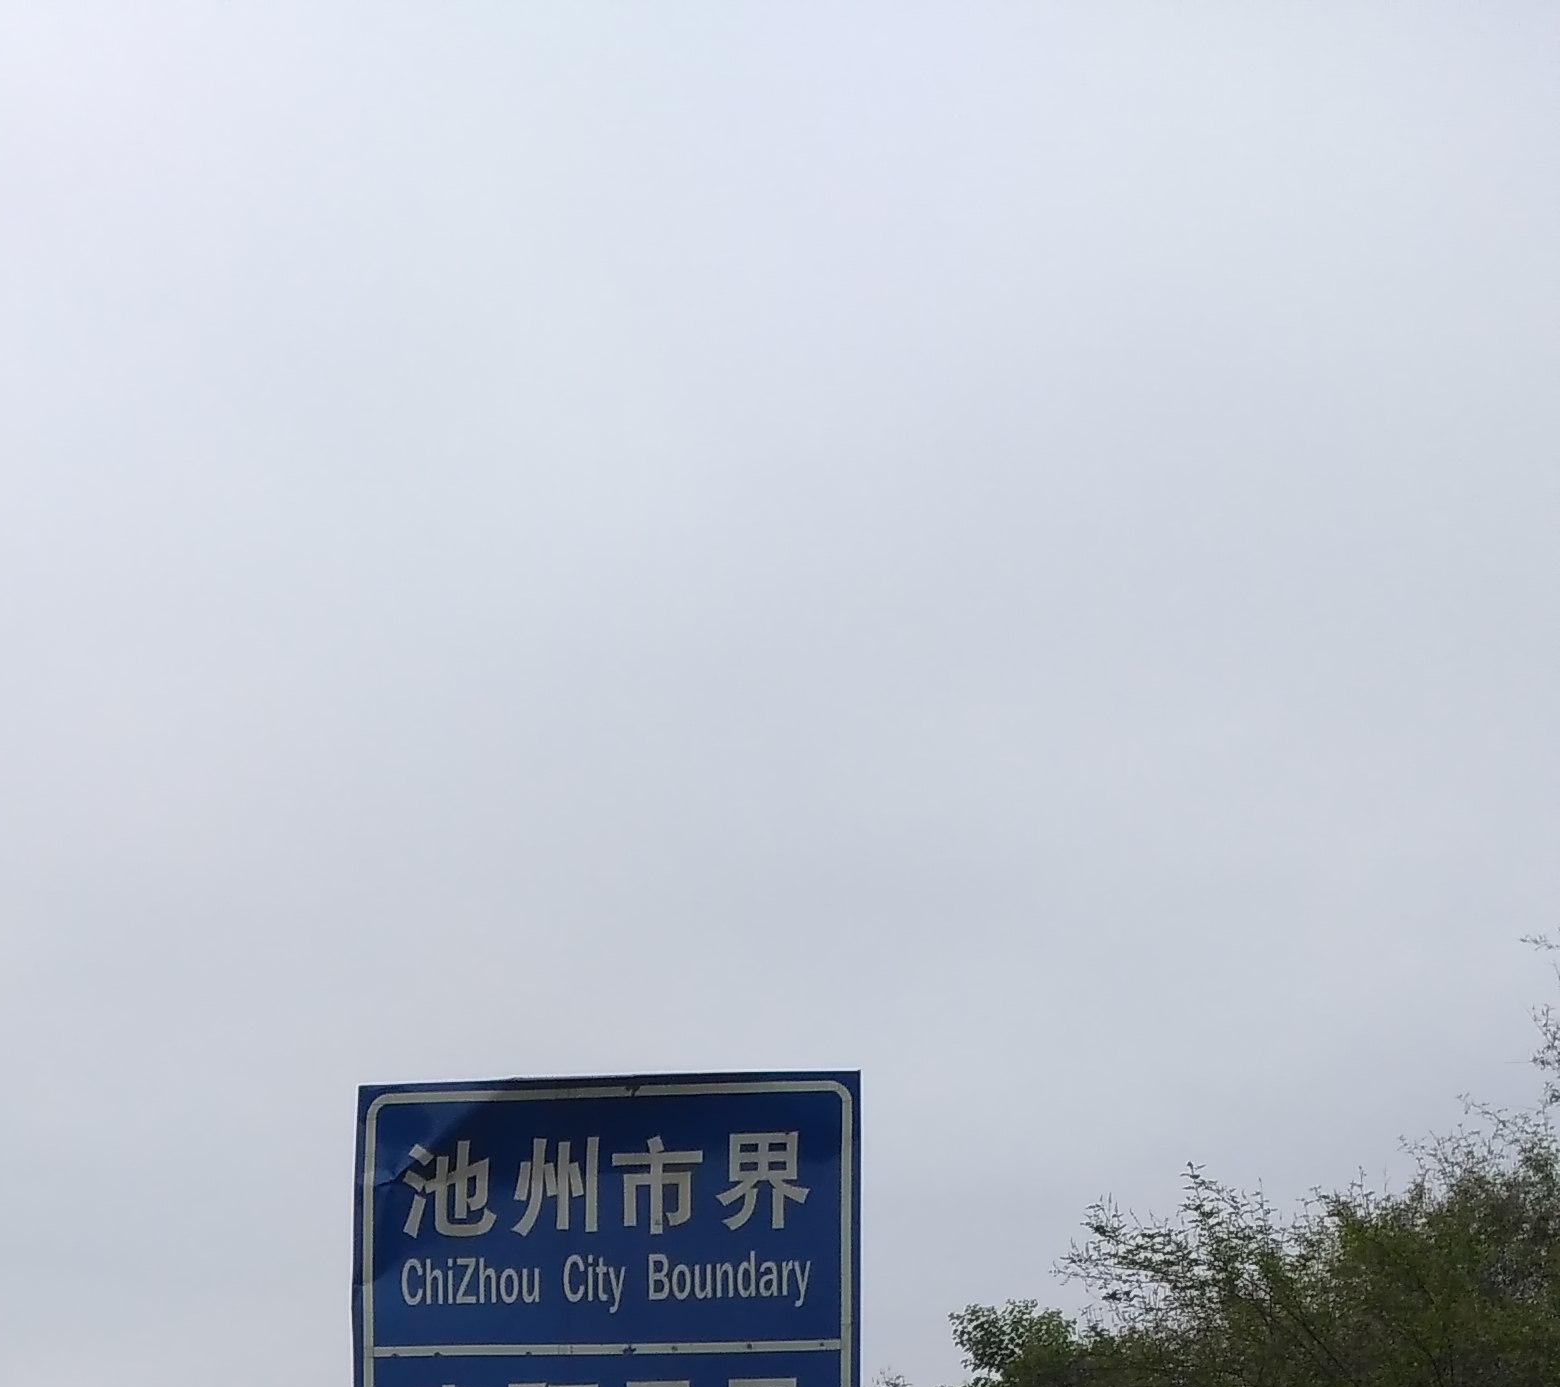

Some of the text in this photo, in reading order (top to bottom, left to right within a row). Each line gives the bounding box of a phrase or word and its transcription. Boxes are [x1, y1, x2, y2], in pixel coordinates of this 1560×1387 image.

[402, 1131, 811, 1238] 池州市界
[401, 1250, 811, 1313] ChiZhou City Boundary
